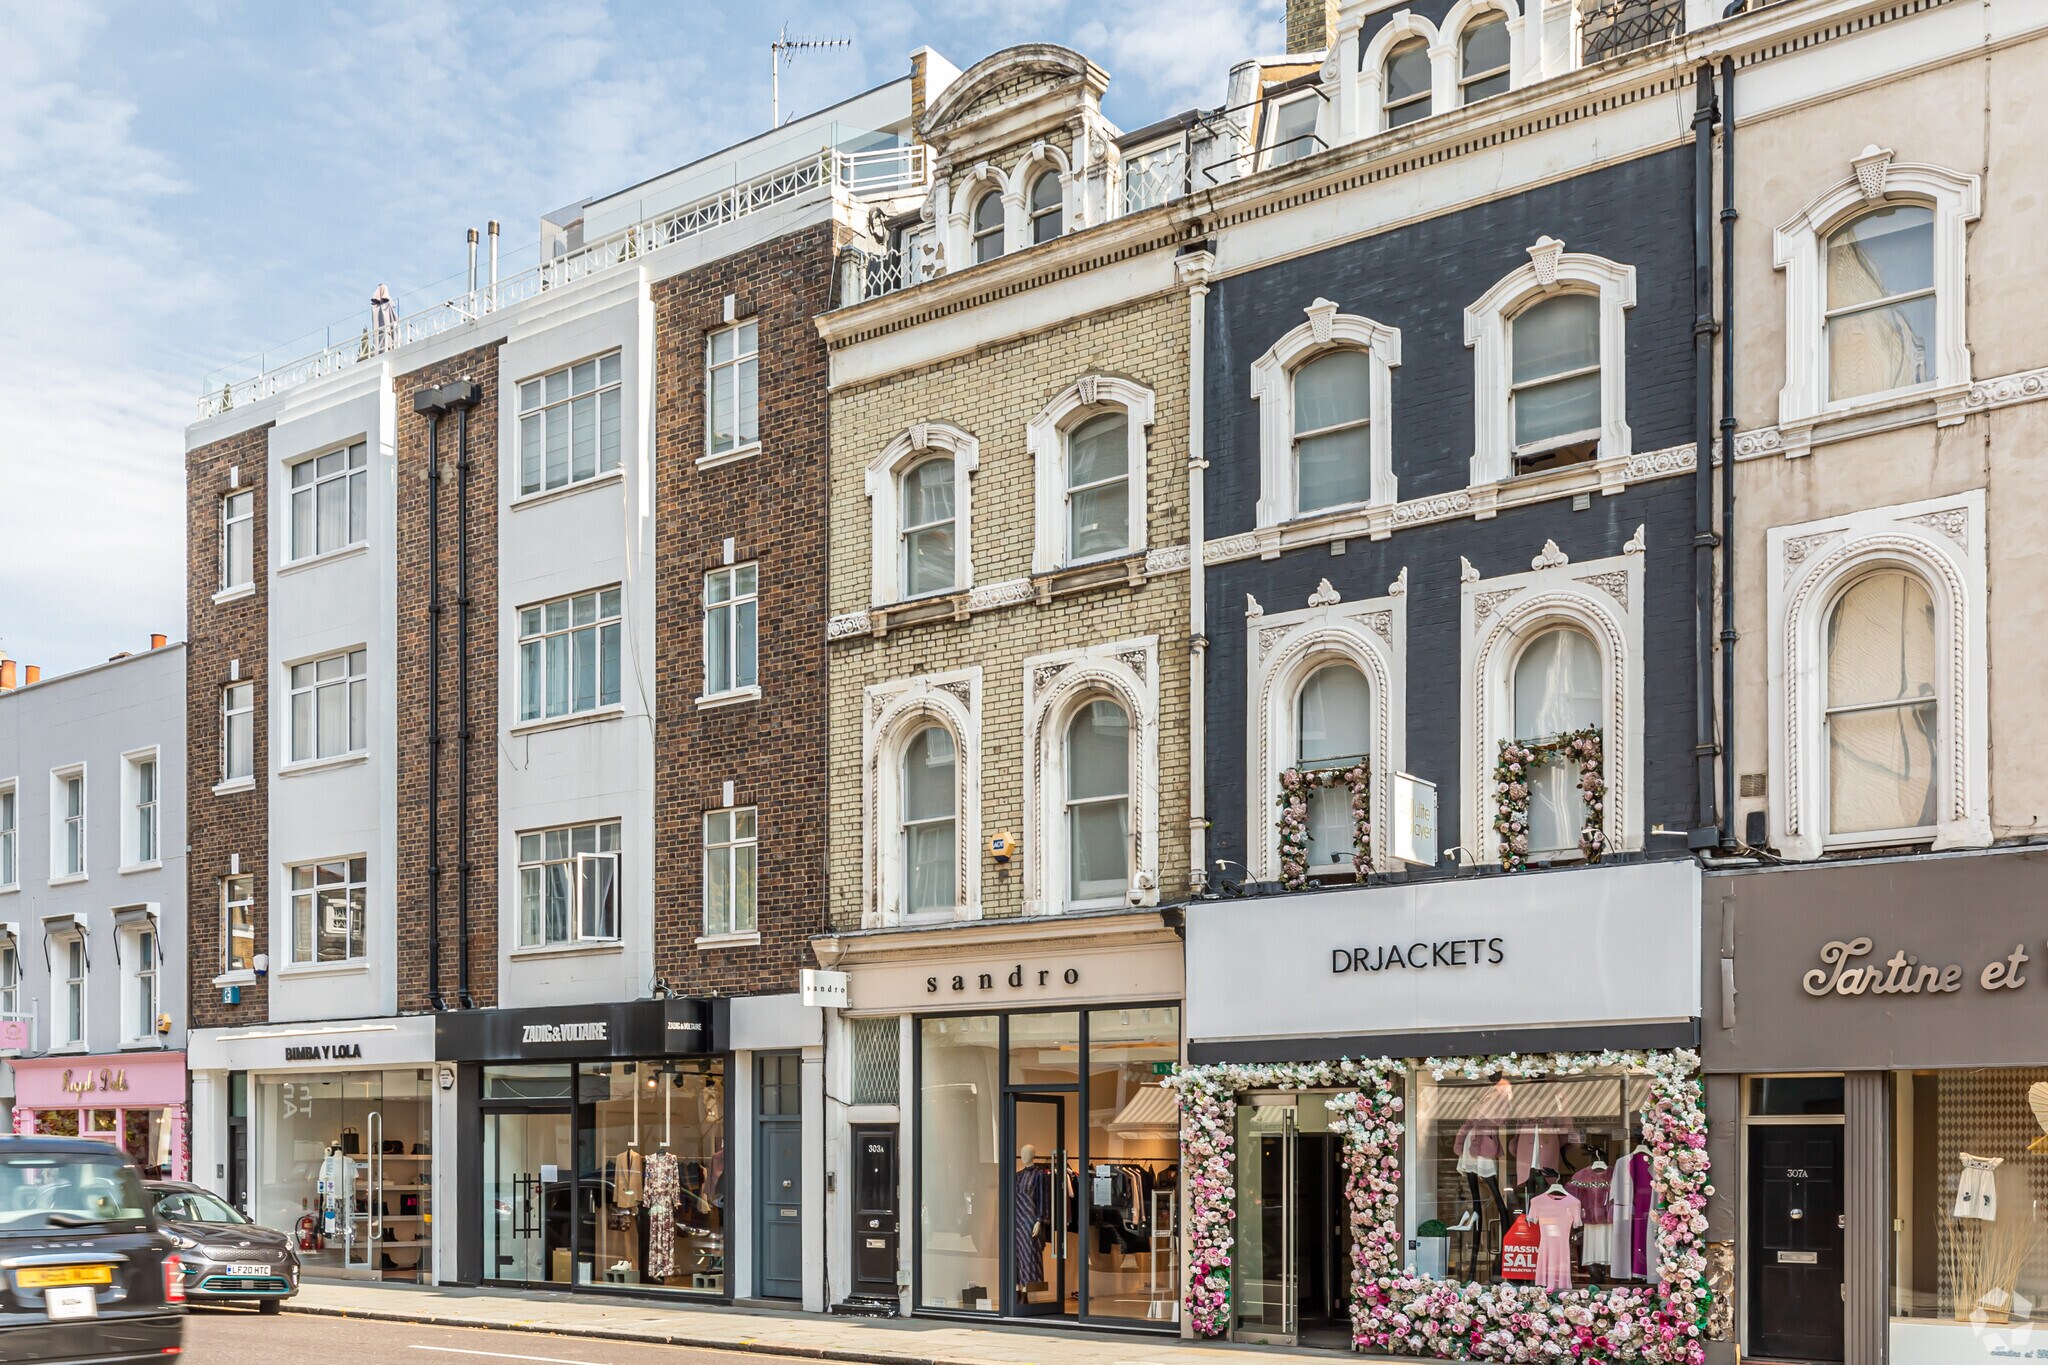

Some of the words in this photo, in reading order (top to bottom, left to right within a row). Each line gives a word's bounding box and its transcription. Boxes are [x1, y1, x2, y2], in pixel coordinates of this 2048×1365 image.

[1332, 937, 1504, 974] DRJACKETS
[1803, 937, 1962, 996] Tartine
[1981, 943, 2029, 990] et
[927, 964, 1079, 993] sandro
[807, 984, 846, 994] sandro
[523, 1021, 608, 1043] ZADIG&VOLTAIRE
[285, 1046, 321, 1061] BIMBA
[322, 1045, 330, 1059] Y
[332, 1043, 362, 1059] LOLA
[868, 1144, 885, 1153] 303A
[1786, 1169, 1809, 1178] 307A
[1504, 1245, 1540, 1253] MASSIV
[1503, 1252, 1537, 1268] SAL
[232, 1266, 253, 1275] LF20
[254, 1266, 269, 1275] HTC
